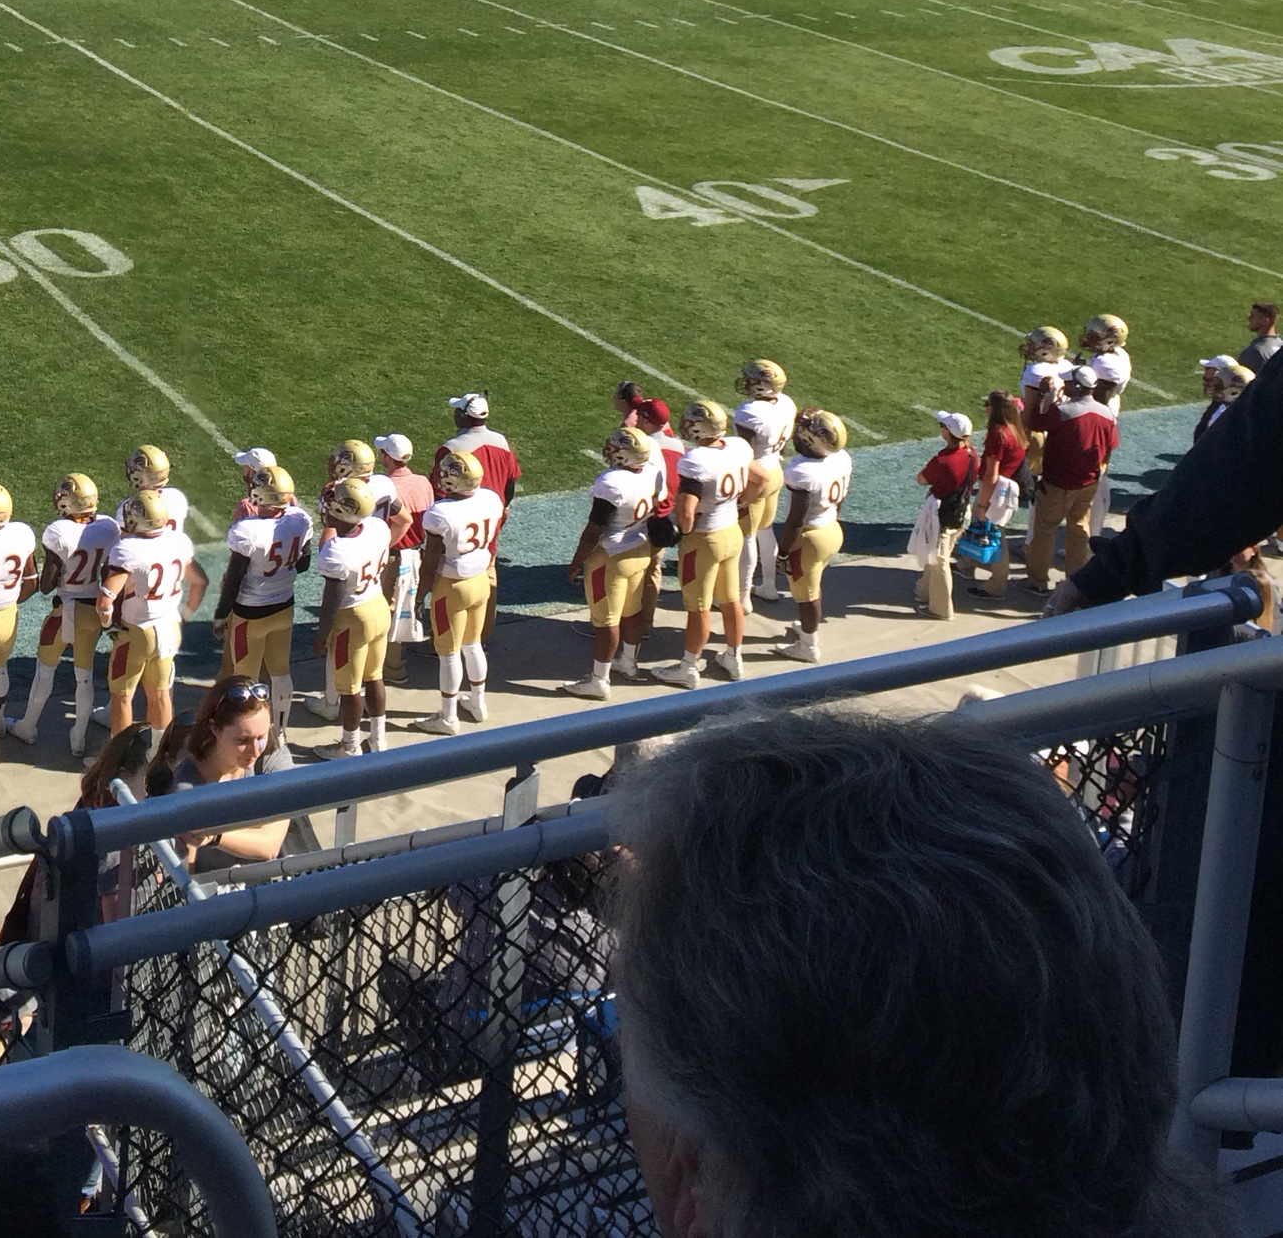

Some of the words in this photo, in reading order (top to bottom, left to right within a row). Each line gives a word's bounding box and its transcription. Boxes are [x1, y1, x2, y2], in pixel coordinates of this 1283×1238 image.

[635, 180, 818, 227] 40
[263, 536, 301, 577] 54
[460, 518, 490, 555] 31
[66, 548, 105, 586] 21
[146, 558, 183, 601] 22
